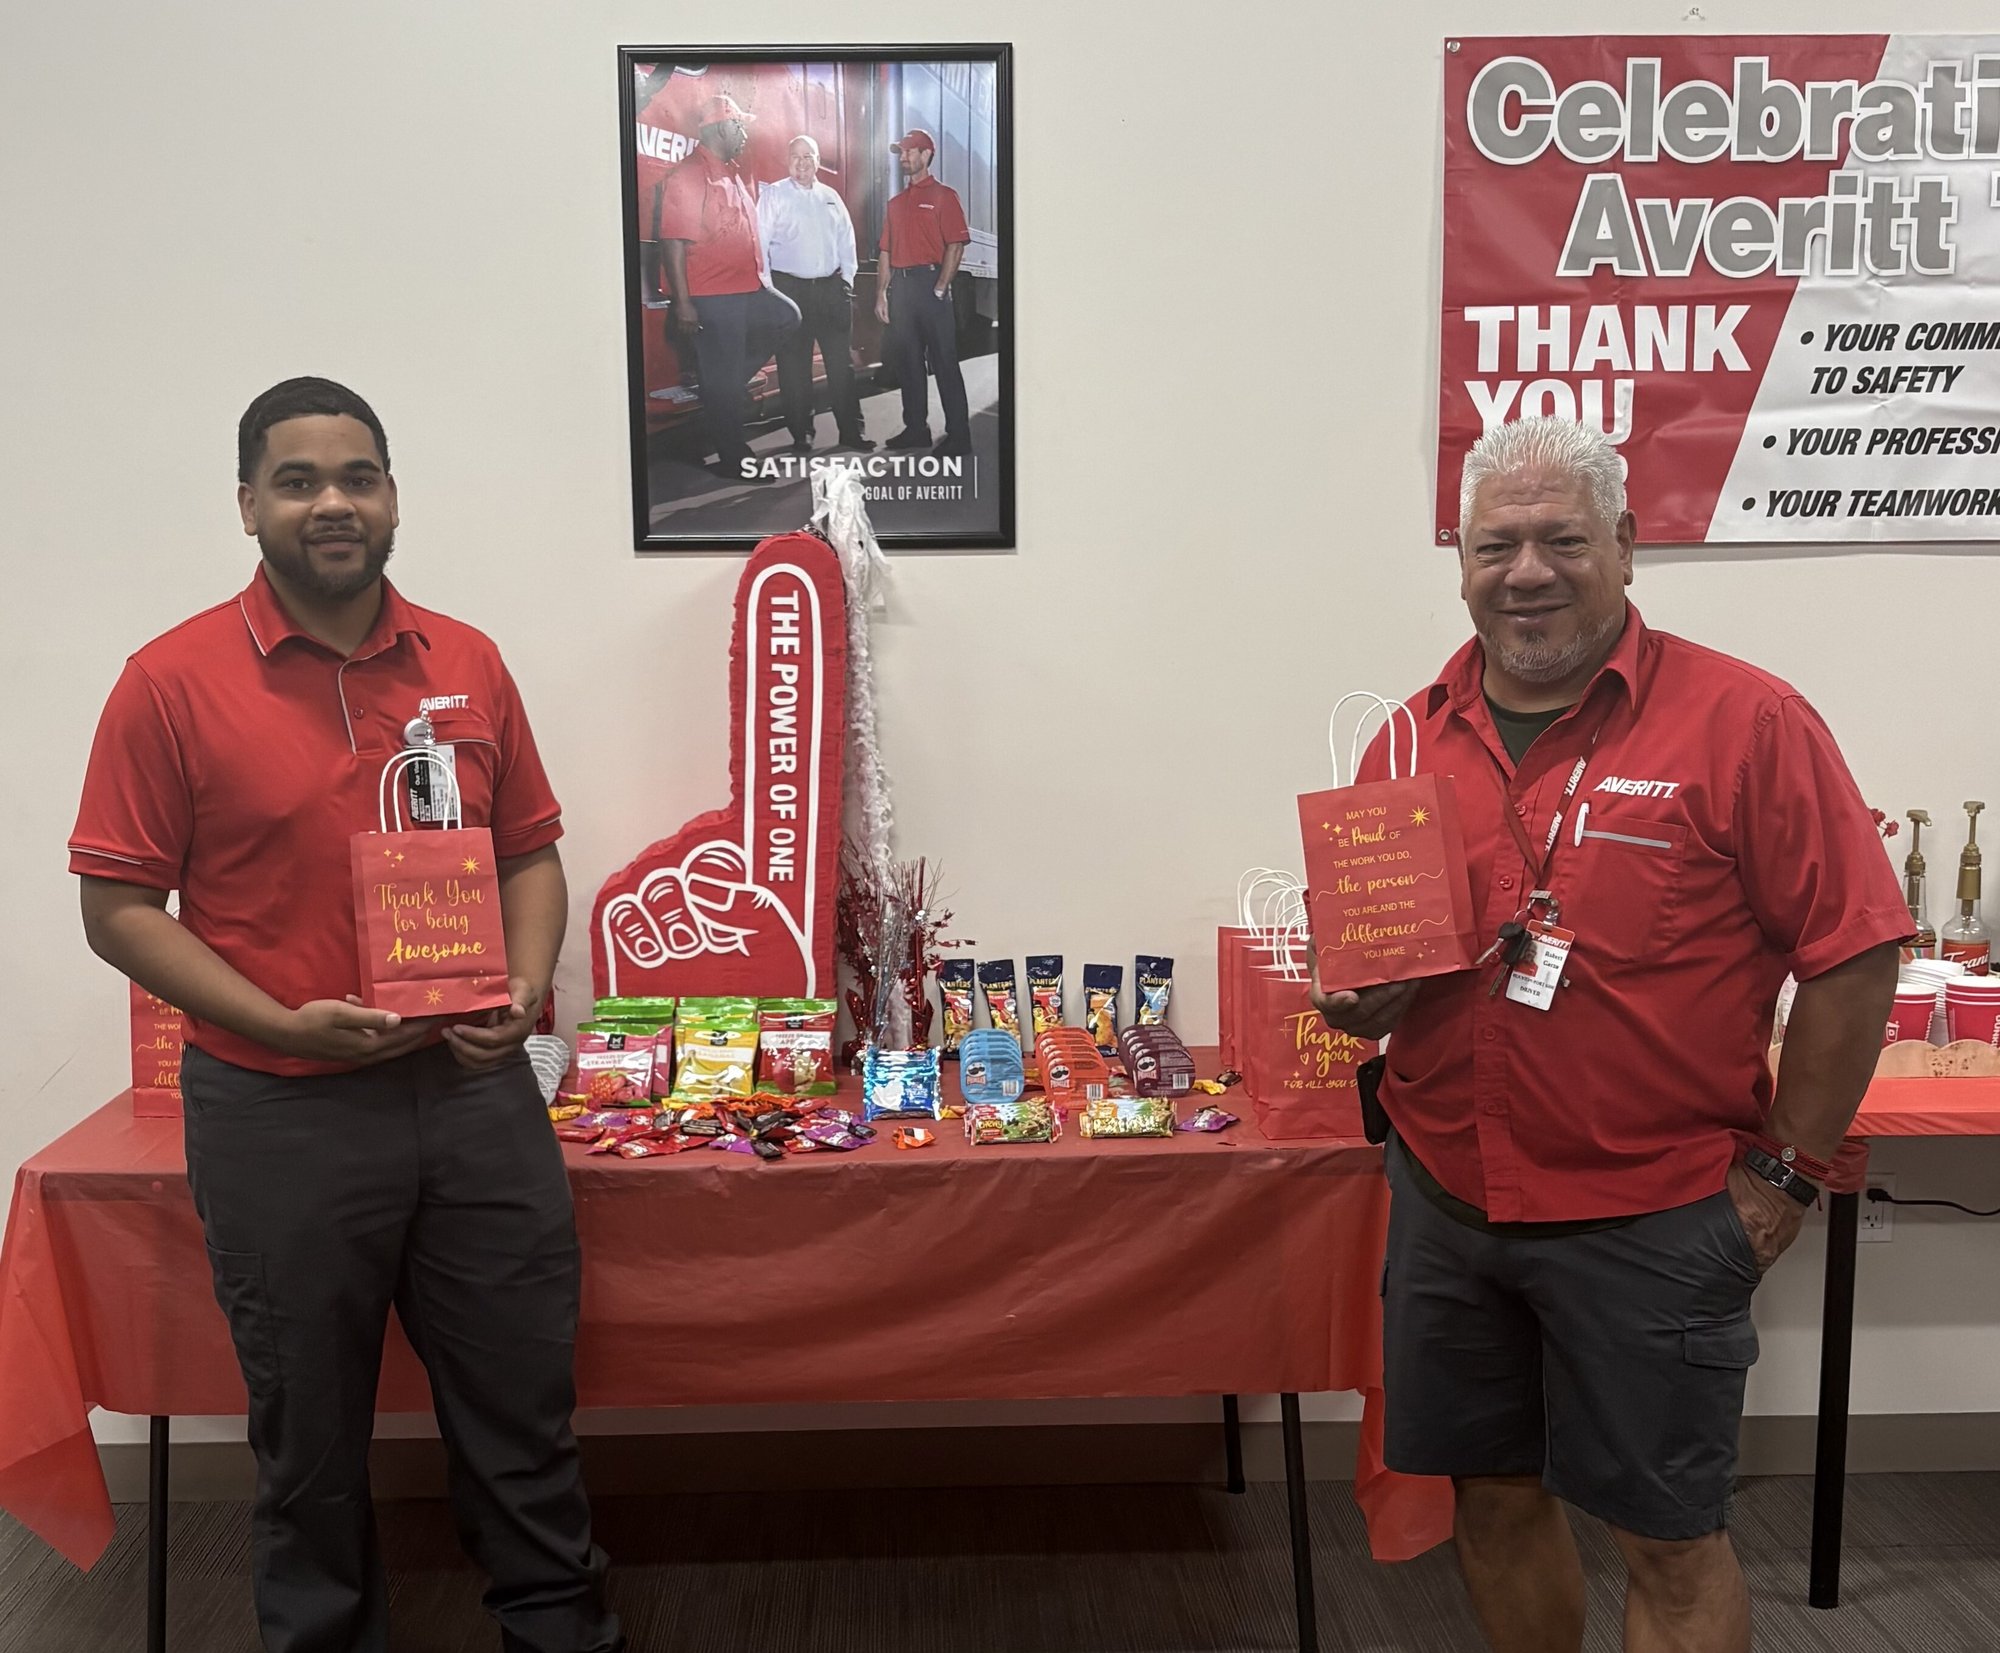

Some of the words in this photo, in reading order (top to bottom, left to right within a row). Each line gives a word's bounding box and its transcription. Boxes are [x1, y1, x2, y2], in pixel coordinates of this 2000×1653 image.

[636, 122, 699, 162] VERI
[1556, 169, 1958, 278] Averitt
[1464, 305, 1751, 372] THANK
[1824, 324, 1900, 351] YOUR
[1810, 367, 1848, 394] TO
[1852, 366, 1965, 394] SAFETY
[1786, 428, 1862, 455] YOUR
[865, 487, 894, 500] GOAL
[899, 487, 912, 500] OF
[916, 486, 963, 499] AVERITT
[1766, 490, 1842, 517] YOUR
[1847, 489, 2000, 517] TEAMWORK
[770, 590, 800, 656] THE
[419, 695, 469, 711] AVERITT
[769, 663, 799, 775] POWER
[1564, 756, 1587, 796] AVERITT
[1594, 776, 1680, 798] AVERITT
[769, 783, 797, 820] OF
[1346, 809, 1366, 820] MAY
[1366, 806, 1387, 817] YOU
[1338, 838, 1350, 848] BE
[1351, 823, 1387, 847] Proud
[1389, 830, 1401, 840] OF
[768, 828, 796, 882] ONE
[1333, 860, 1349, 870] THE
[1350, 855, 1376, 867] WORK
[1377, 852, 1396, 863] YOU
[373, 881, 437, 911] Thank
[446, 879, 485, 905] You
[1336, 875, 1361, 895] the
[1367, 874, 1417, 895] person
[426, 909, 470, 935] being
[1343, 907, 1361, 918] YOU
[1399, 900, 1416, 910] THE
[1341, 922, 1420, 945] difference
[386, 937, 487, 964] Awesome
[1363, 949, 1382, 960] YOU
[1383, 946, 1406, 957] MAKE
[1316, 1049, 1354, 1078] you
[1305, 1080, 1323, 1089] ALL
